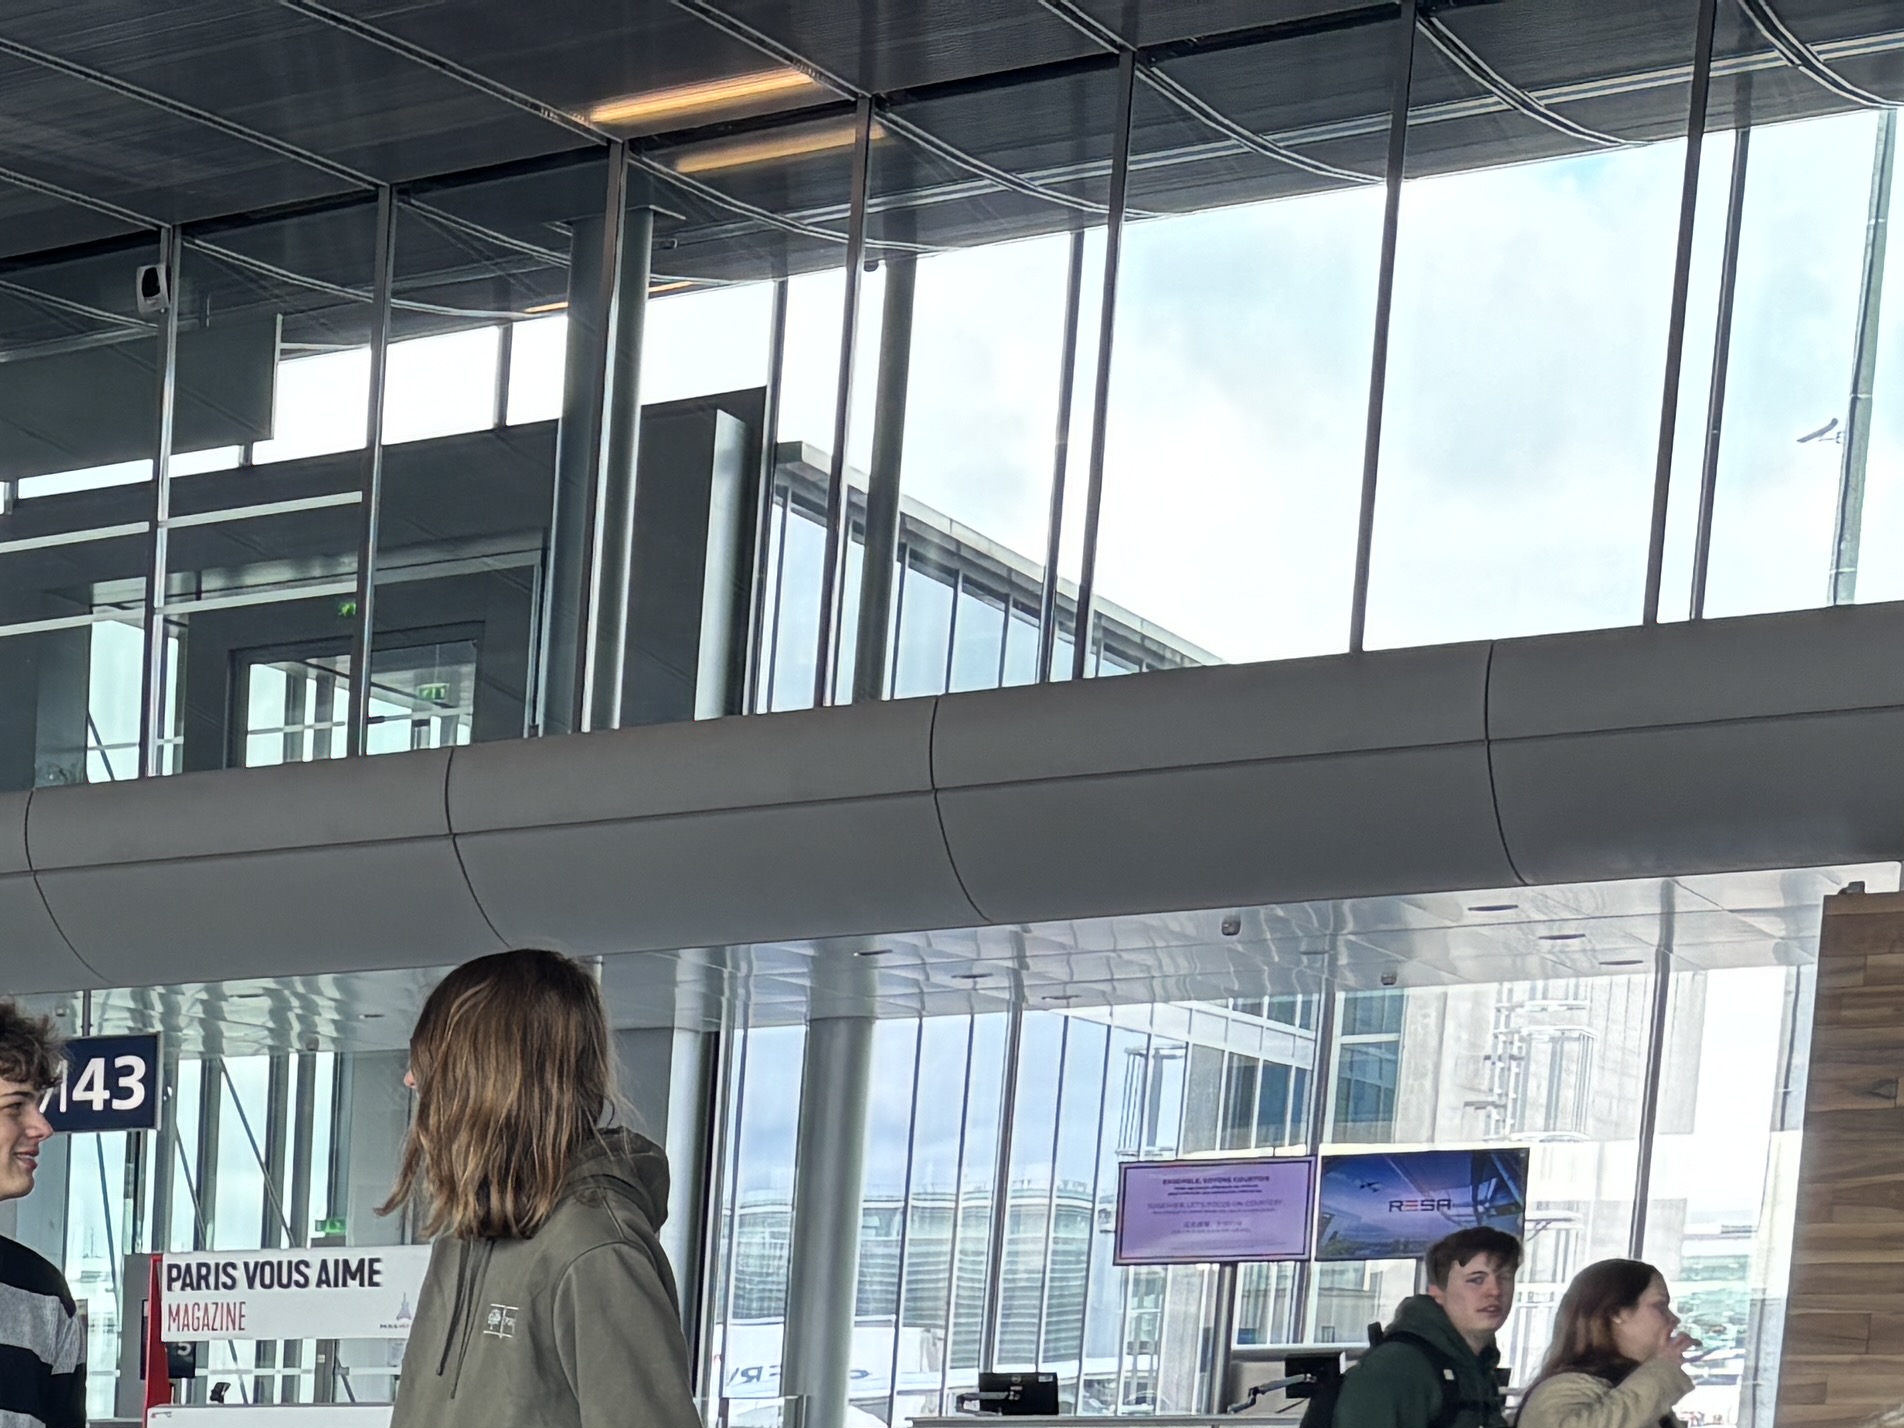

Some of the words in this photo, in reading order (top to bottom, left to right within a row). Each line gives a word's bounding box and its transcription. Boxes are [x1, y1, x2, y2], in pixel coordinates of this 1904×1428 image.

[1389, 1199, 1452, 1212] RESA
[166, 1262, 238, 1292] PARIS
[244, 1259, 311, 1290] VOUS
[315, 1257, 383, 1289] AIME
[167, 1301, 246, 1333] MAGAZINE
